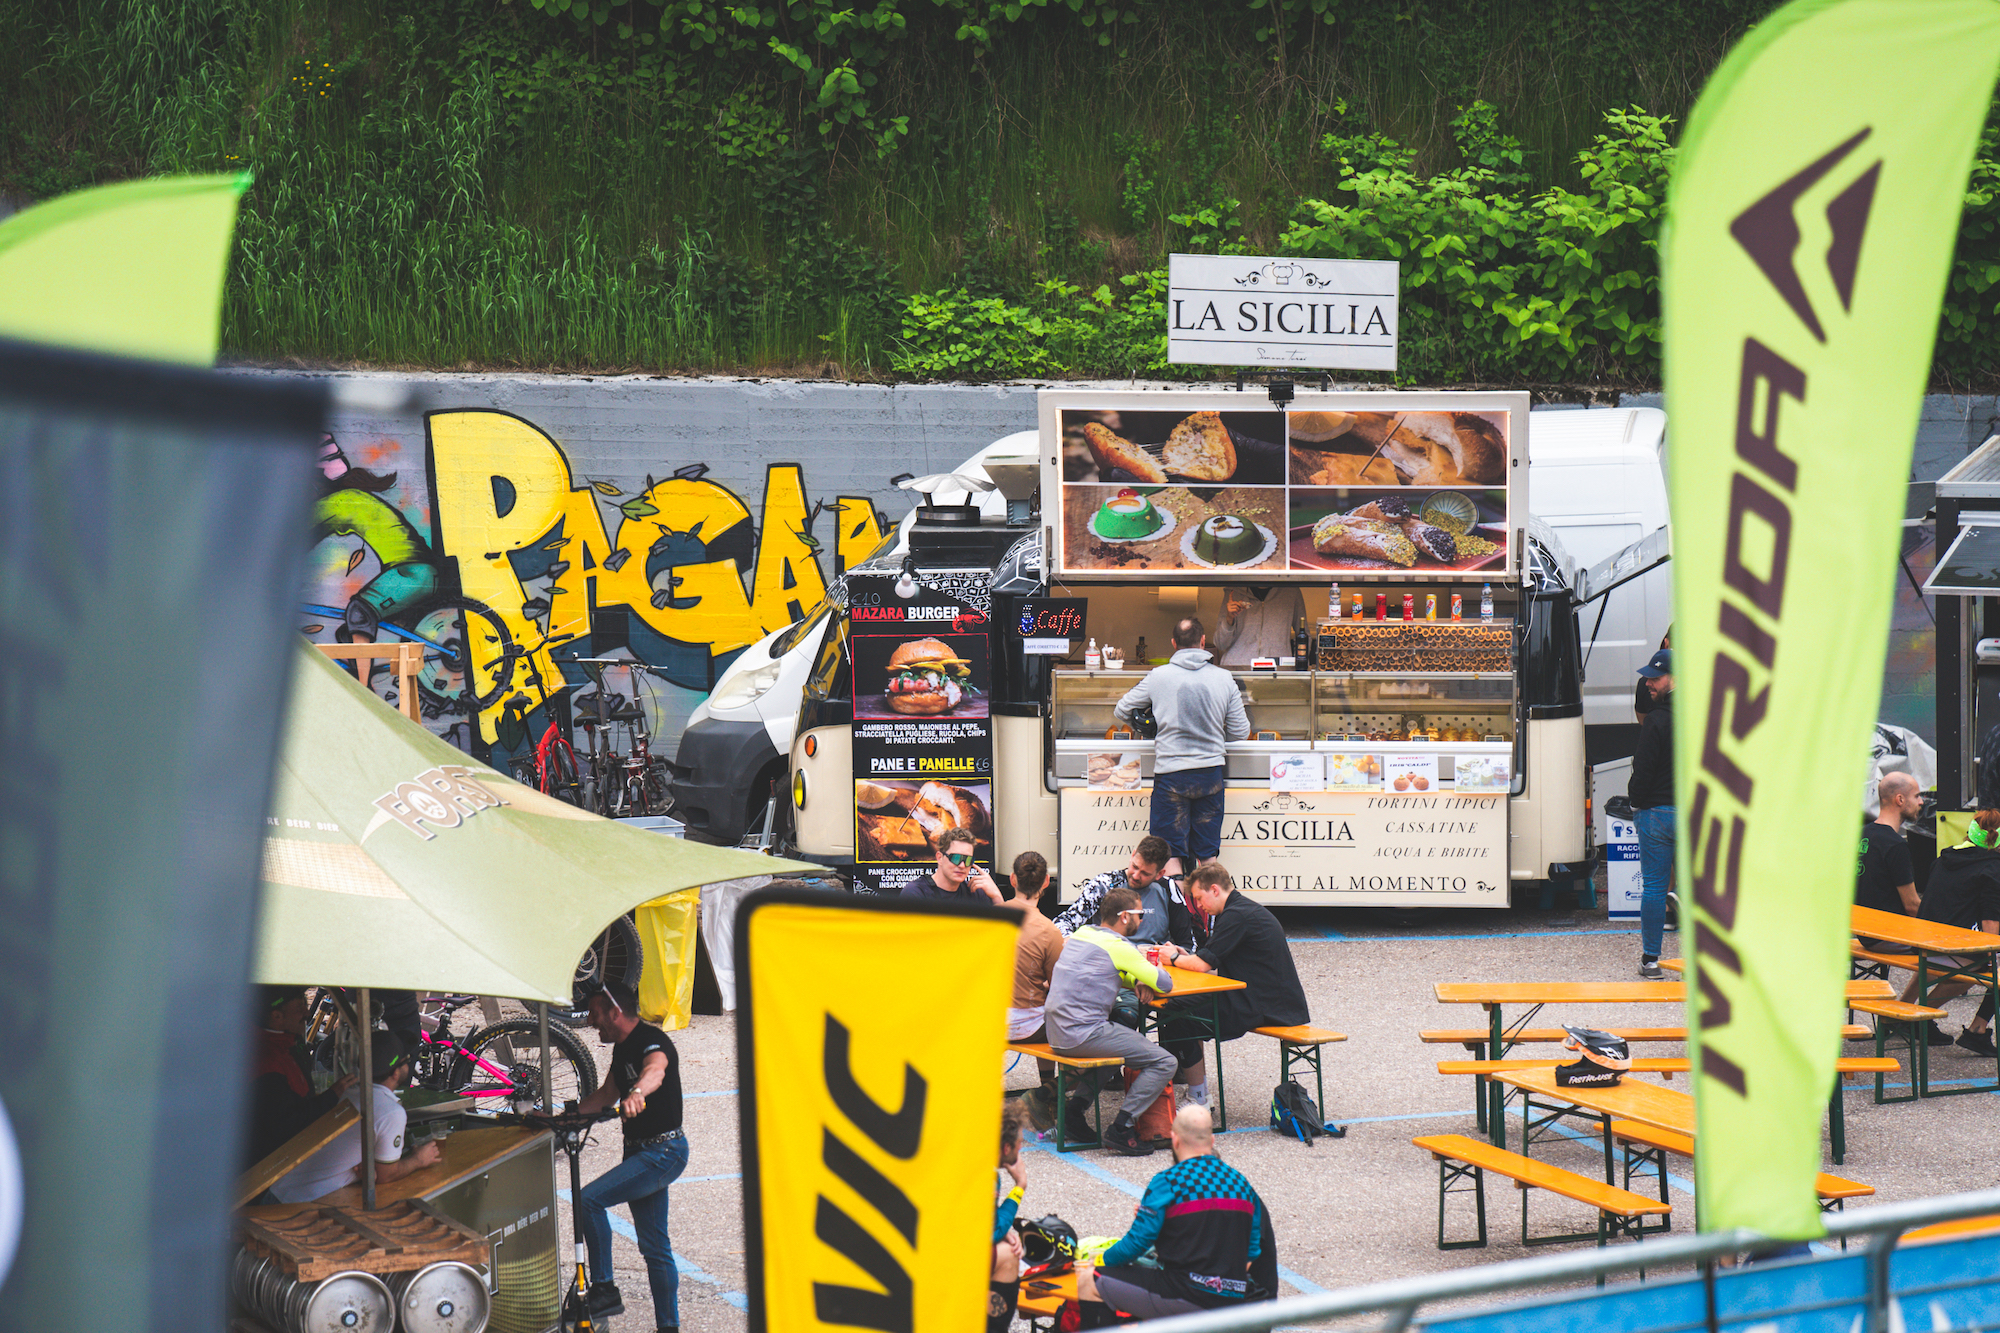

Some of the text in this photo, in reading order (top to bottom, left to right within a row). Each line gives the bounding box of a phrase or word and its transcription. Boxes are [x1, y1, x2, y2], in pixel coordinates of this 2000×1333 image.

[1172, 299, 1392, 336] LA SICILIA
[851, 606, 960, 620] MAZARA BURGER
[1689, 335, 1808, 1099] MERIDA
[918, 723, 951, 731] MAIONESE
[952, 723, 960, 731] AL
[961, 723, 980, 731] PEPE,
[854, 729, 987, 738] STRACCIATELLA PUGLIESE, RUCOLA, CHIPS
[917, 736, 956, 744] CROCCANTI.
[870, 757, 975, 771] PANE E PANELLE
[1367, 798, 1497, 810] TORTINI TIPICI
[286, 818, 311, 829] BEER
[316, 821, 340, 832] BIER
[1097, 820, 1150, 831] PANEL
[1256, 820, 1355, 841] SICILIA
[1385, 822, 1479, 834] CASSATINE
[1072, 845, 1134, 856] PATATIN
[1373, 847, 1490, 859] ACQUA E BIBITE
[868, 868, 885, 876] PANE
[886, 868, 925, 876] CROCCANTE
[925, 868, 934, 876] AL
[879, 881, 908, 889] INSAPOR
[1230, 875, 1467, 891] ARCITI AL MOMENTO
[504, 1223, 516, 1238] BIRRA
[529, 1211, 539, 1225] BEER
[540, 1206, 549, 1220] BIER
